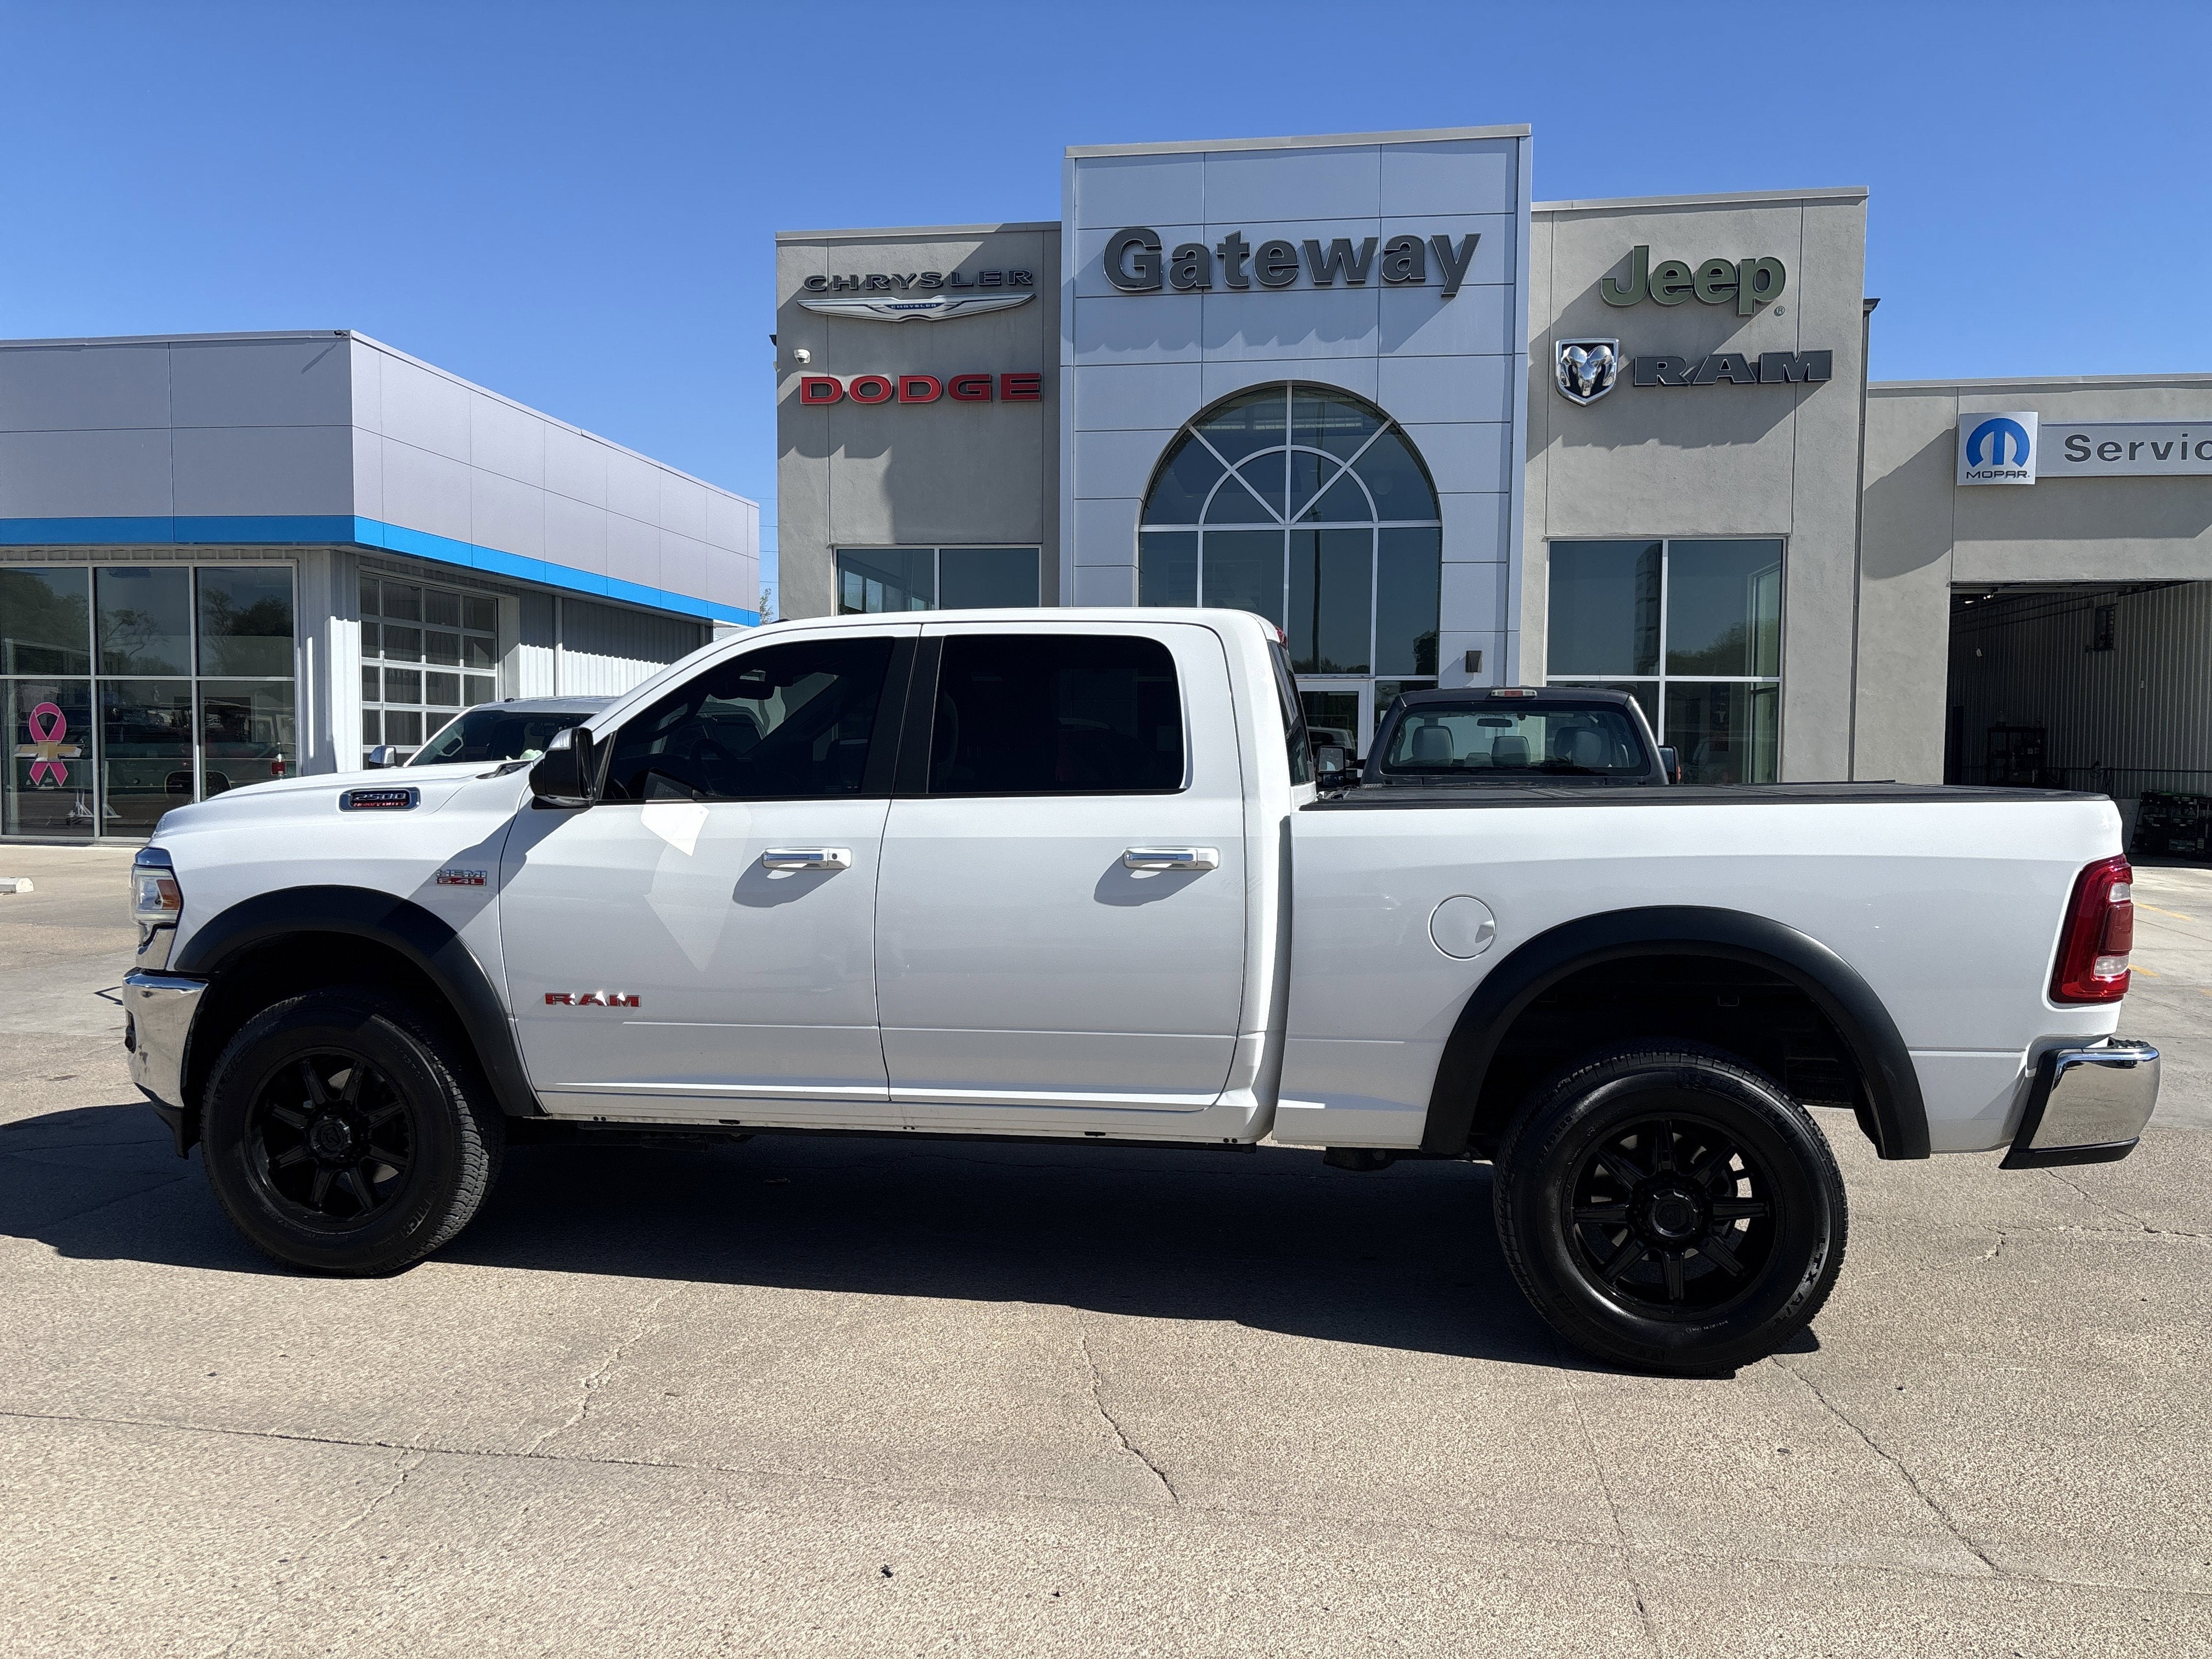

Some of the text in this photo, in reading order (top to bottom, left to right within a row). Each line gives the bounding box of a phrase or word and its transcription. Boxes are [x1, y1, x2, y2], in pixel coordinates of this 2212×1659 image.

[1103, 227, 1481, 297] Gateway
[802, 269, 1033, 291] CHRYSLER
[1600, 245, 1786, 317] Jeep
[1633, 349, 1833, 387] RAM
[800, 373, 1041, 404] DODGE
[1966, 470, 2028, 479] MOPAR
[352, 793, 407, 801] 2500
[545, 992, 641, 1007] RAM
[1805, 1237, 1826, 1285] LTX
